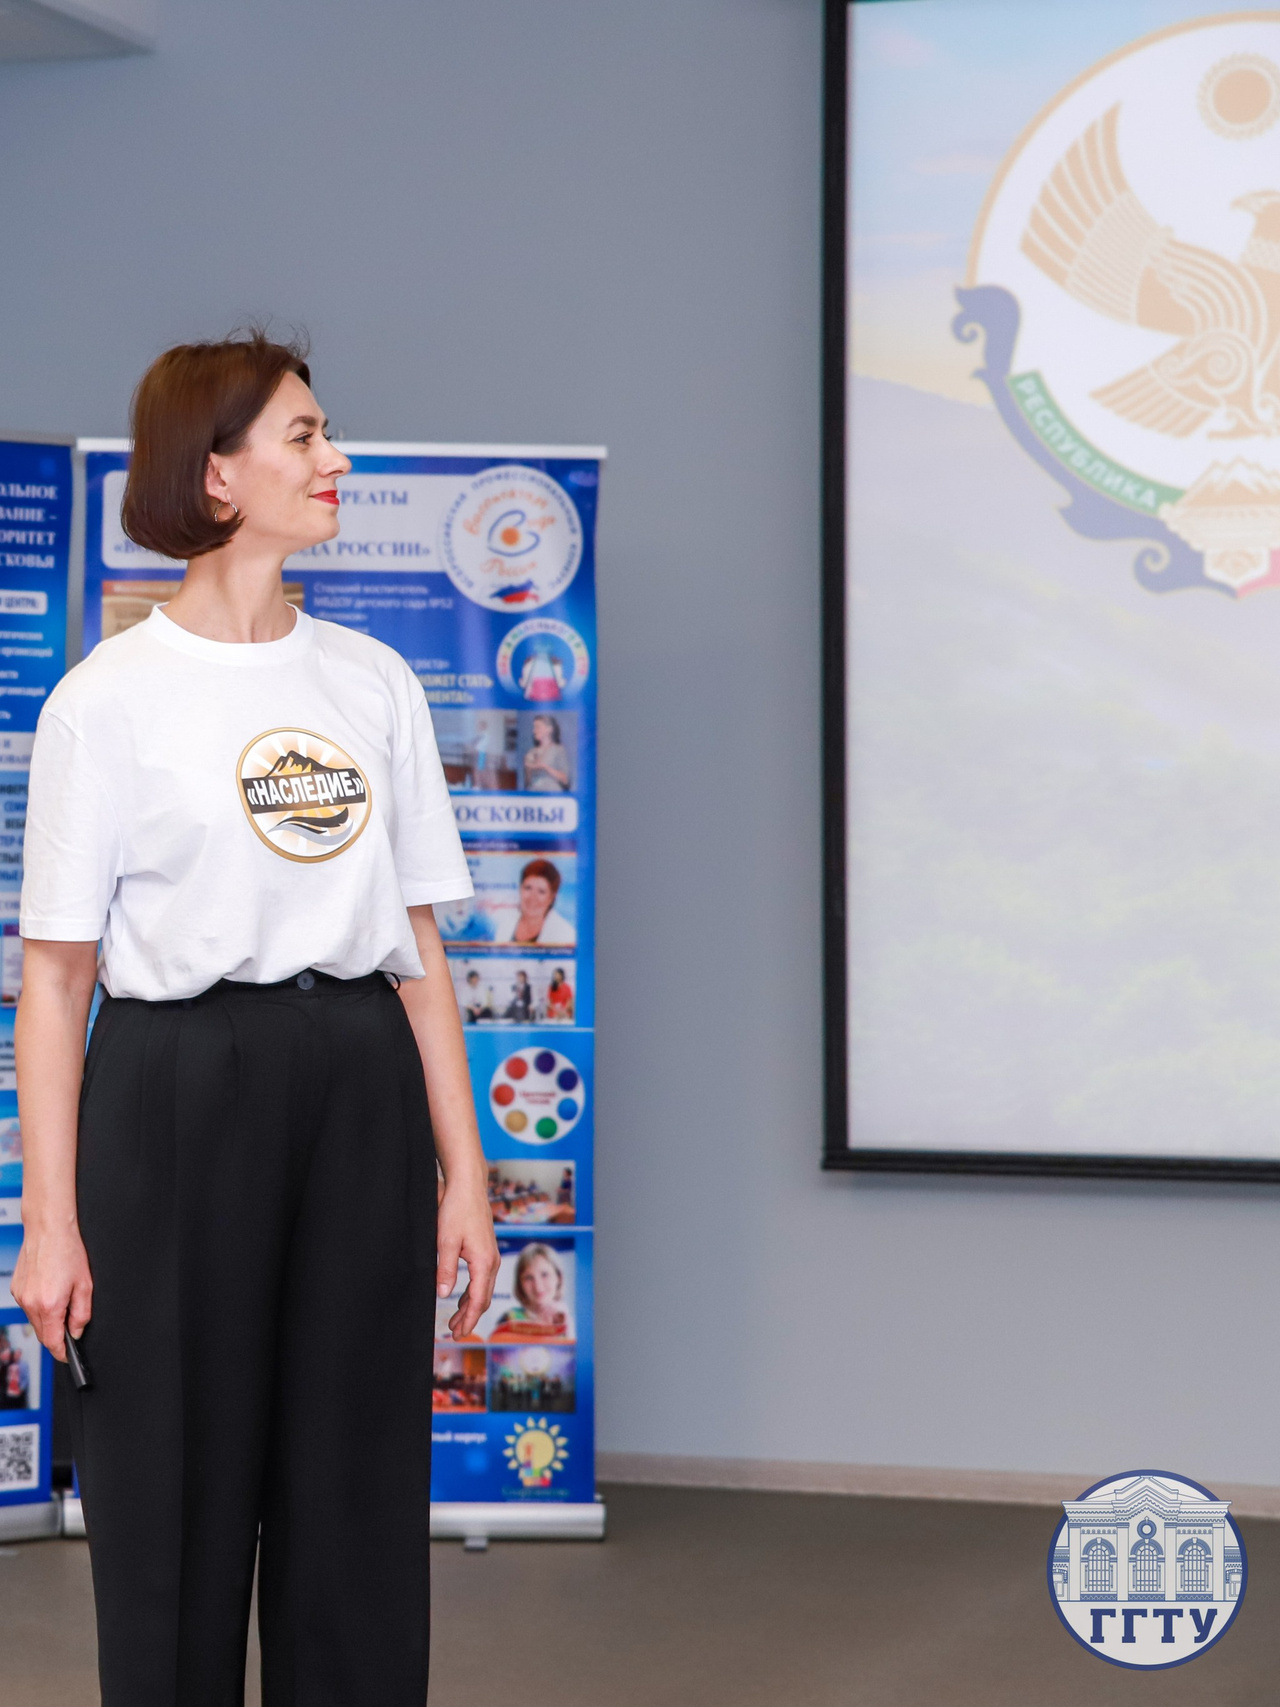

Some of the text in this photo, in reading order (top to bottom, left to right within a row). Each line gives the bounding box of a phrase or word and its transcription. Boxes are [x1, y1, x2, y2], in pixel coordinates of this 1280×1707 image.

[1017, 378, 1156, 508] РЕСПУБЛИКА
[341, 490, 409, 506] РЕАТЫ
[336, 541, 431, 557] РОССИИ»
[247, 771, 365, 806] «НАСЛЕДИЕ»
[456, 805, 564, 824] ОСКОВЬЯ
